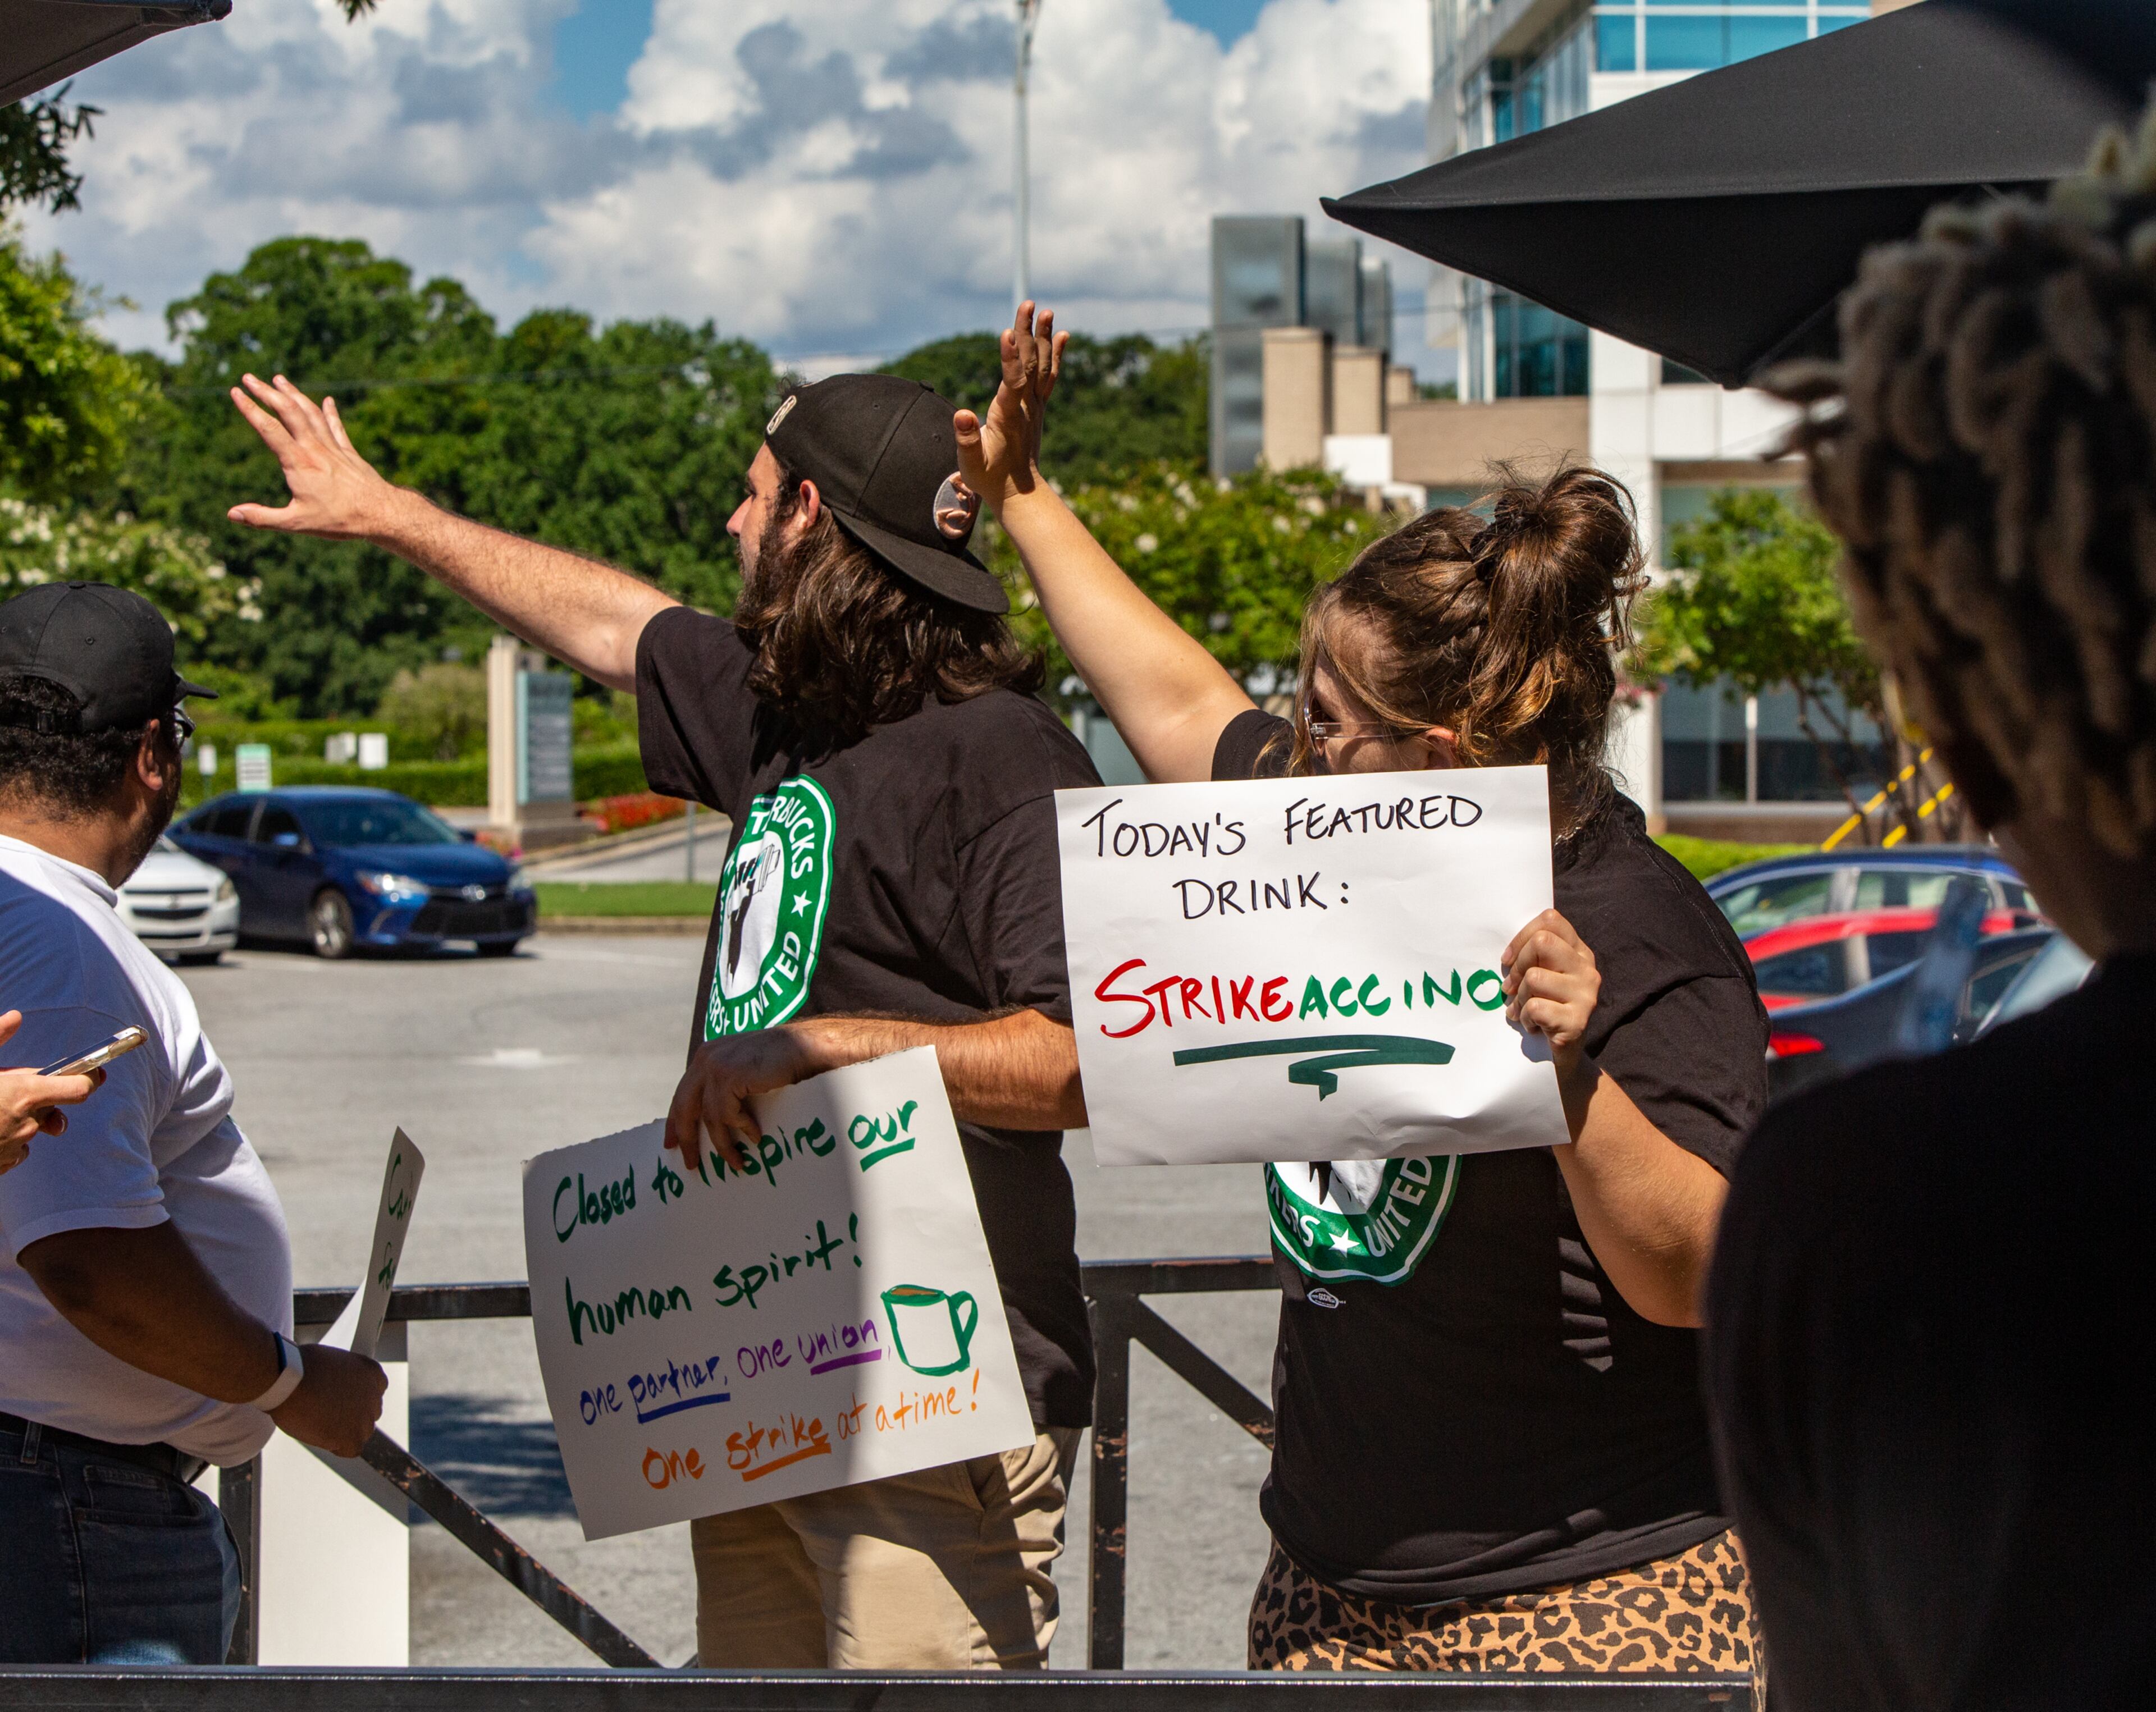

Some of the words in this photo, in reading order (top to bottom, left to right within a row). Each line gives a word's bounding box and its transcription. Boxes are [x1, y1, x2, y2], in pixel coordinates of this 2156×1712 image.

[1081, 799, 1246, 858] TODAY'S
[1284, 795, 1483, 845] FEATURED
[1172, 871, 1349, 919] DRINK:
[1094, 958, 1508, 1038] STRIKEACCINO
[553, 1162, 636, 1243] Closed
[651, 1155, 684, 1205] to
[848, 1100, 919, 1150] our
[565, 1277, 692, 1345] human
[712, 1211, 863, 1309] spirit!
[725, 1412, 830, 1470] strike
[838, 1391, 868, 1440] at
